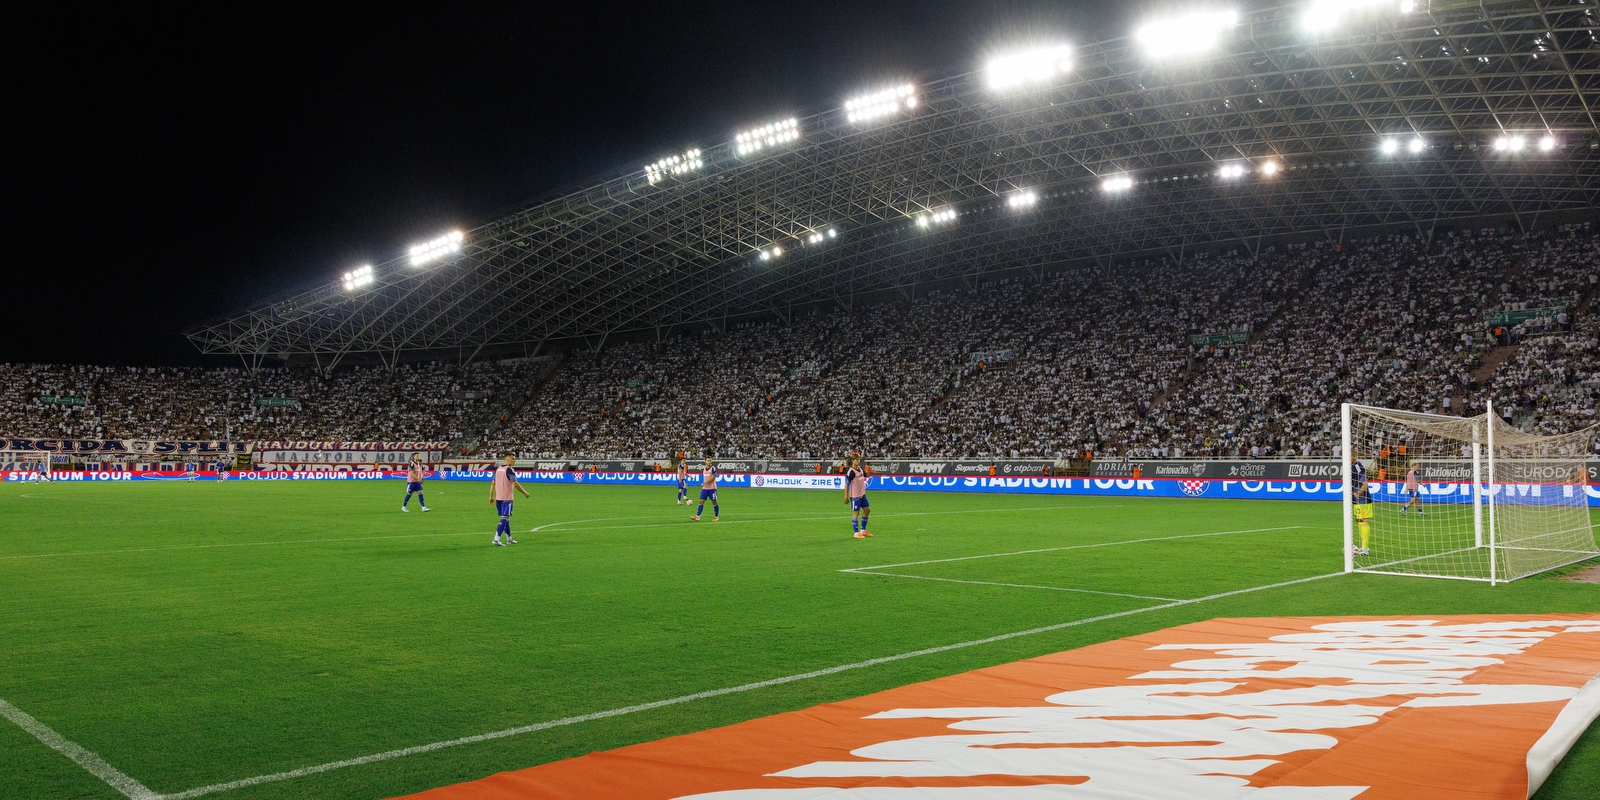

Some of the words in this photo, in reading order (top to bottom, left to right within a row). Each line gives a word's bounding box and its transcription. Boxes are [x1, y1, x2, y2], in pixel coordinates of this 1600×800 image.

[154, 440, 252, 453] SPLIT
[257, 441, 335, 450] HAJDUK
[275, 452, 352, 462] MAJSTOR
[360, 452, 368, 462] S
[537, 462, 566, 470] TOMMY
[908, 463, 947, 474] TOMMY
[954, 464, 997, 473] SuperSpo
[1155, 465, 1189, 475] Karlovačko
[1302, 465, 1343, 476] LUKO
[90, 471, 132, 480] TOUR
[240, 471, 288, 480] POLJUD
[292, 471, 347, 480] STADIUM
[352, 471, 384, 480] TOUR
[1425, 467, 1471, 478] Karlovačko
[714, 474, 746, 483] OUR
[766, 478, 802, 486] HAJDUK
